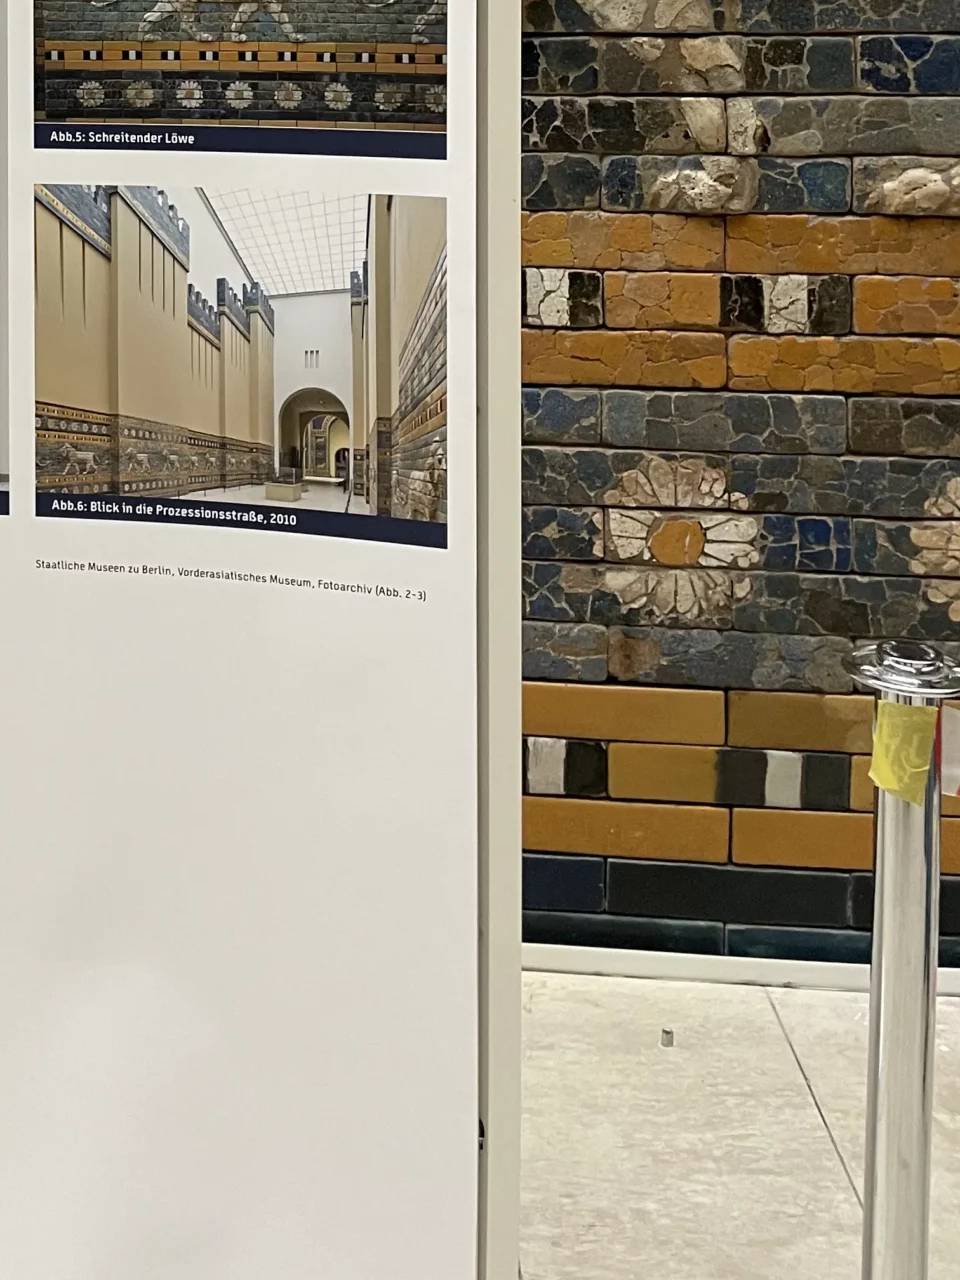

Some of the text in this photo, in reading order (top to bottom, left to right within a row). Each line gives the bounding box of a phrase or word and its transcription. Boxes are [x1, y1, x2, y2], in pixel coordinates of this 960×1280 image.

[50, 130, 195, 145] Abb.5: Schreitender Löwe
[51, 499, 297, 526] Abb.6: Blick in die Prozessionsstraße, 2010
[35, 559, 427, 603] Staatliche Museen zu Berlin, Vorderasiatisches Museum, Fotoarchiv (Abb. 2-3)
